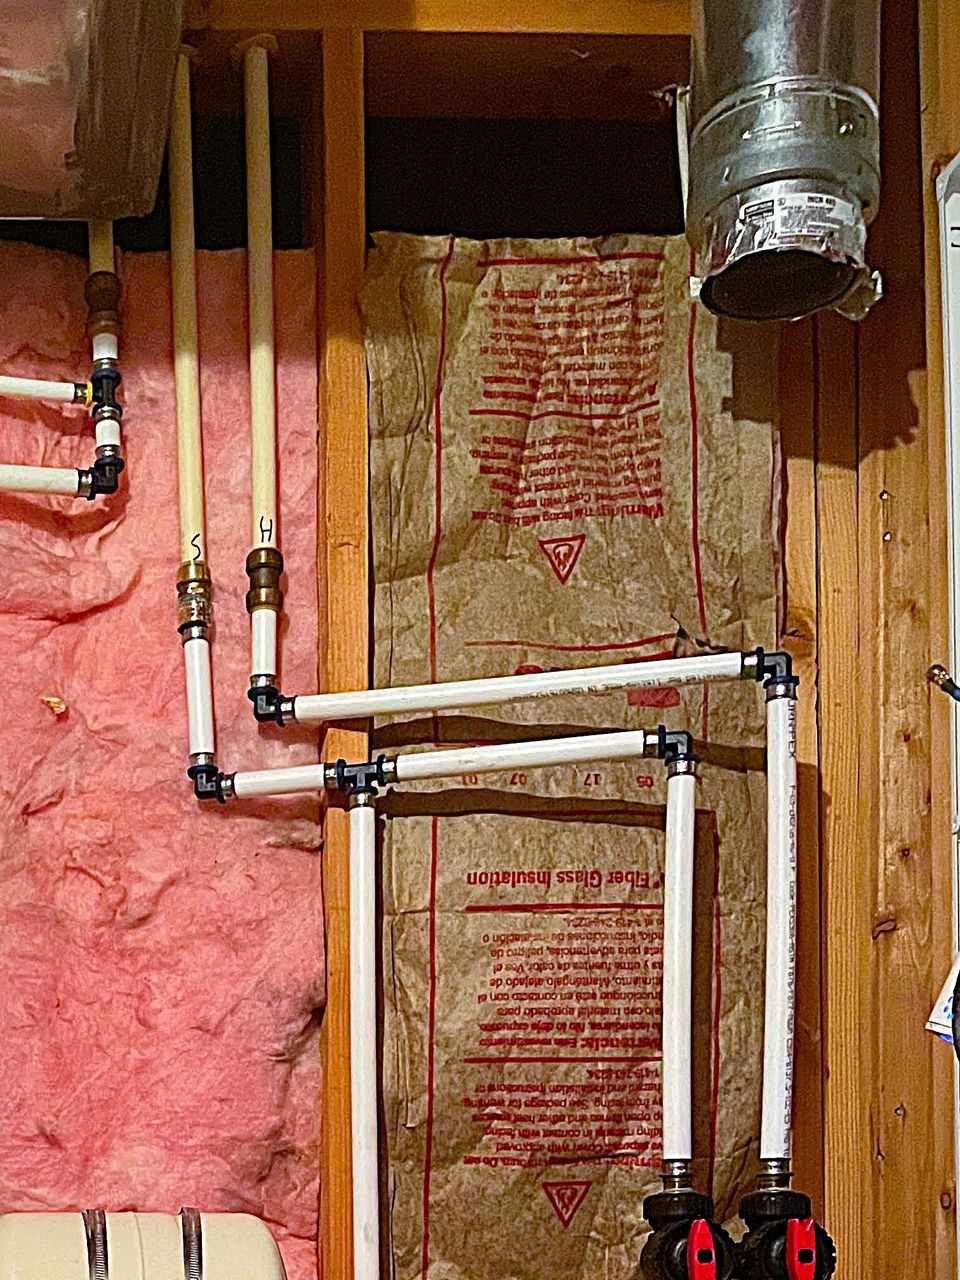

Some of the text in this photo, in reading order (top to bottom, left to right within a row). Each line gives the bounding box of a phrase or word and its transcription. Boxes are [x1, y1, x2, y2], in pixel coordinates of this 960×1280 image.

[259, 516, 273, 543] H
[190, 533, 202, 560] S
[509, 773, 527, 786] 07
[583, 773, 601, 786] 17
[466, 870, 649, 889] Fiber Glass Insulation
[482, 933, 489, 942] o
[490, 949, 504, 958] de
[506, 946, 544, 959] peligro
[546, 946, 616, 958] advertencias,
[618, 946, 641, 956] para
[492, 963, 503, 974] el
[556, 962, 570, 973] de
[572, 961, 612, 973] fuentes
[489, 978, 503, 988] de
[505, 975, 544, 988] alejado
[477, 993, 487, 1004] el
[490, 991, 510, 1002] con
[511, 992, 558, 1002] contacto
[560, 992, 574, 1001] en
[496, 1006, 521, 1017] para
[523, 1005, 575, 1017] aprobado
[569, 1022, 585, 1032] No
[474, 1084, 486, 1093] or
[488, 1084, 546, 1094] instructions
[548, 1084, 605, 1094] installation
[508, 1099, 522, 1109] for
[524, 1098, 567, 1109] package
[569, 1099, 588, 1109] See
[626, 1097, 649, 1108] from
[513, 1114, 535, 1123] heat
[537, 1113, 566, 1123] other
[567, 1114, 587, 1123] and
[623, 1111, 651, 1122] open
[518, 1129, 540, 1139] with
[542, 1128, 580, 1138] contact
[582, 1129, 593, 1138] in
[495, 1142, 545, 1153] approved
[547, 1143, 570, 1154] with
